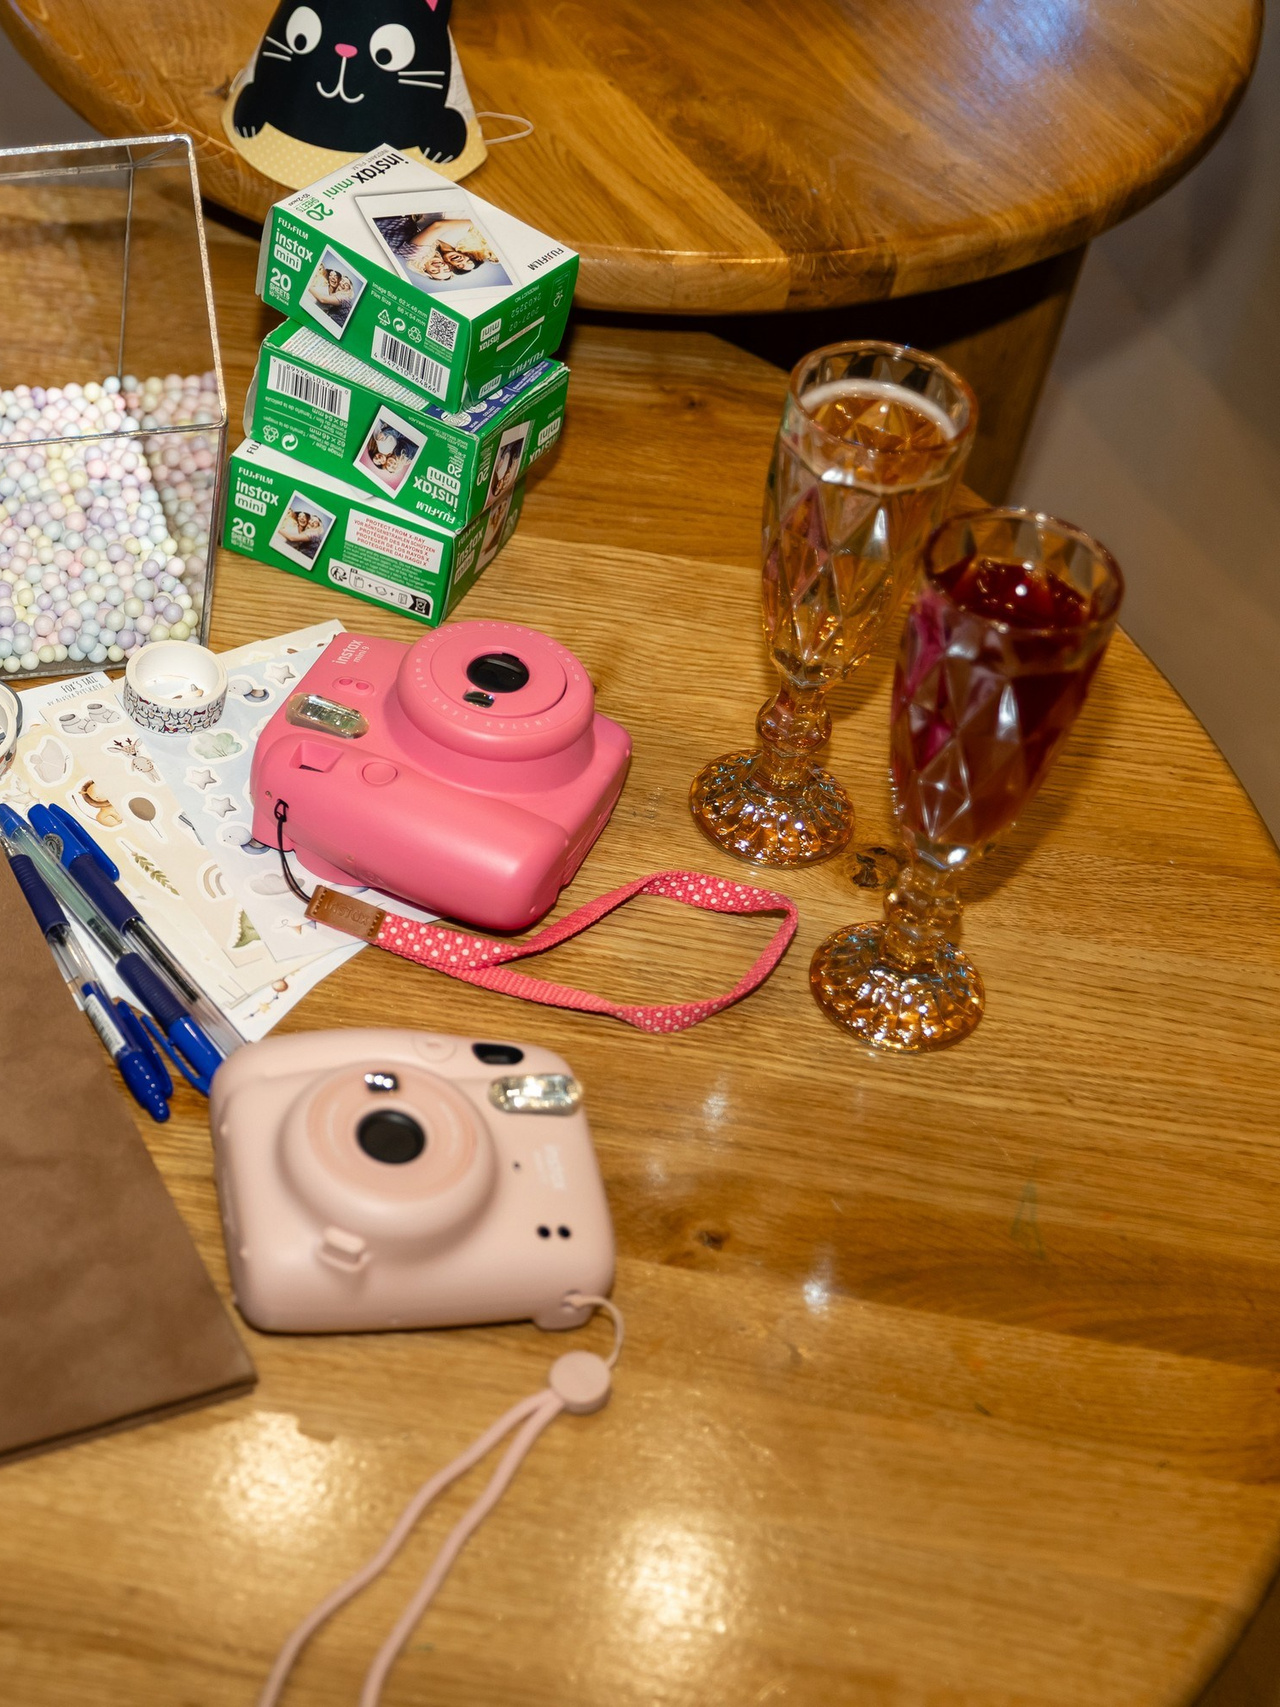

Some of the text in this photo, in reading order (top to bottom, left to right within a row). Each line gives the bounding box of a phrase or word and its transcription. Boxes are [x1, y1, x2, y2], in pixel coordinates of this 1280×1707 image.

[322, 153, 409, 200] instax mini
[306, 202, 334, 221] 20
[277, 217, 309, 240] FUJIFILM
[275, 228, 313, 263] instax
[276, 248, 299, 269] mini
[527, 247, 565, 271] FUJIFILM
[270, 267, 291, 292] 20
[481, 320, 500, 335] mini
[479, 333, 501, 352] instax
[311, 408, 325, 417] mm
[308, 427, 322, 436] mm
[540, 420, 560, 442] mini
[238, 467, 273, 485] FUJIFILM
[430, 469, 458, 490] mini
[447, 464, 463, 478] 20
[477, 465, 490, 487] 20
[236, 477, 279, 506] instax
[413, 476, 458, 513] instax
[237, 497, 264, 513] mini
[416, 501, 456, 524] FUJIFILM
[232, 517, 256, 538] 20
[331, 640, 363, 665] instax
